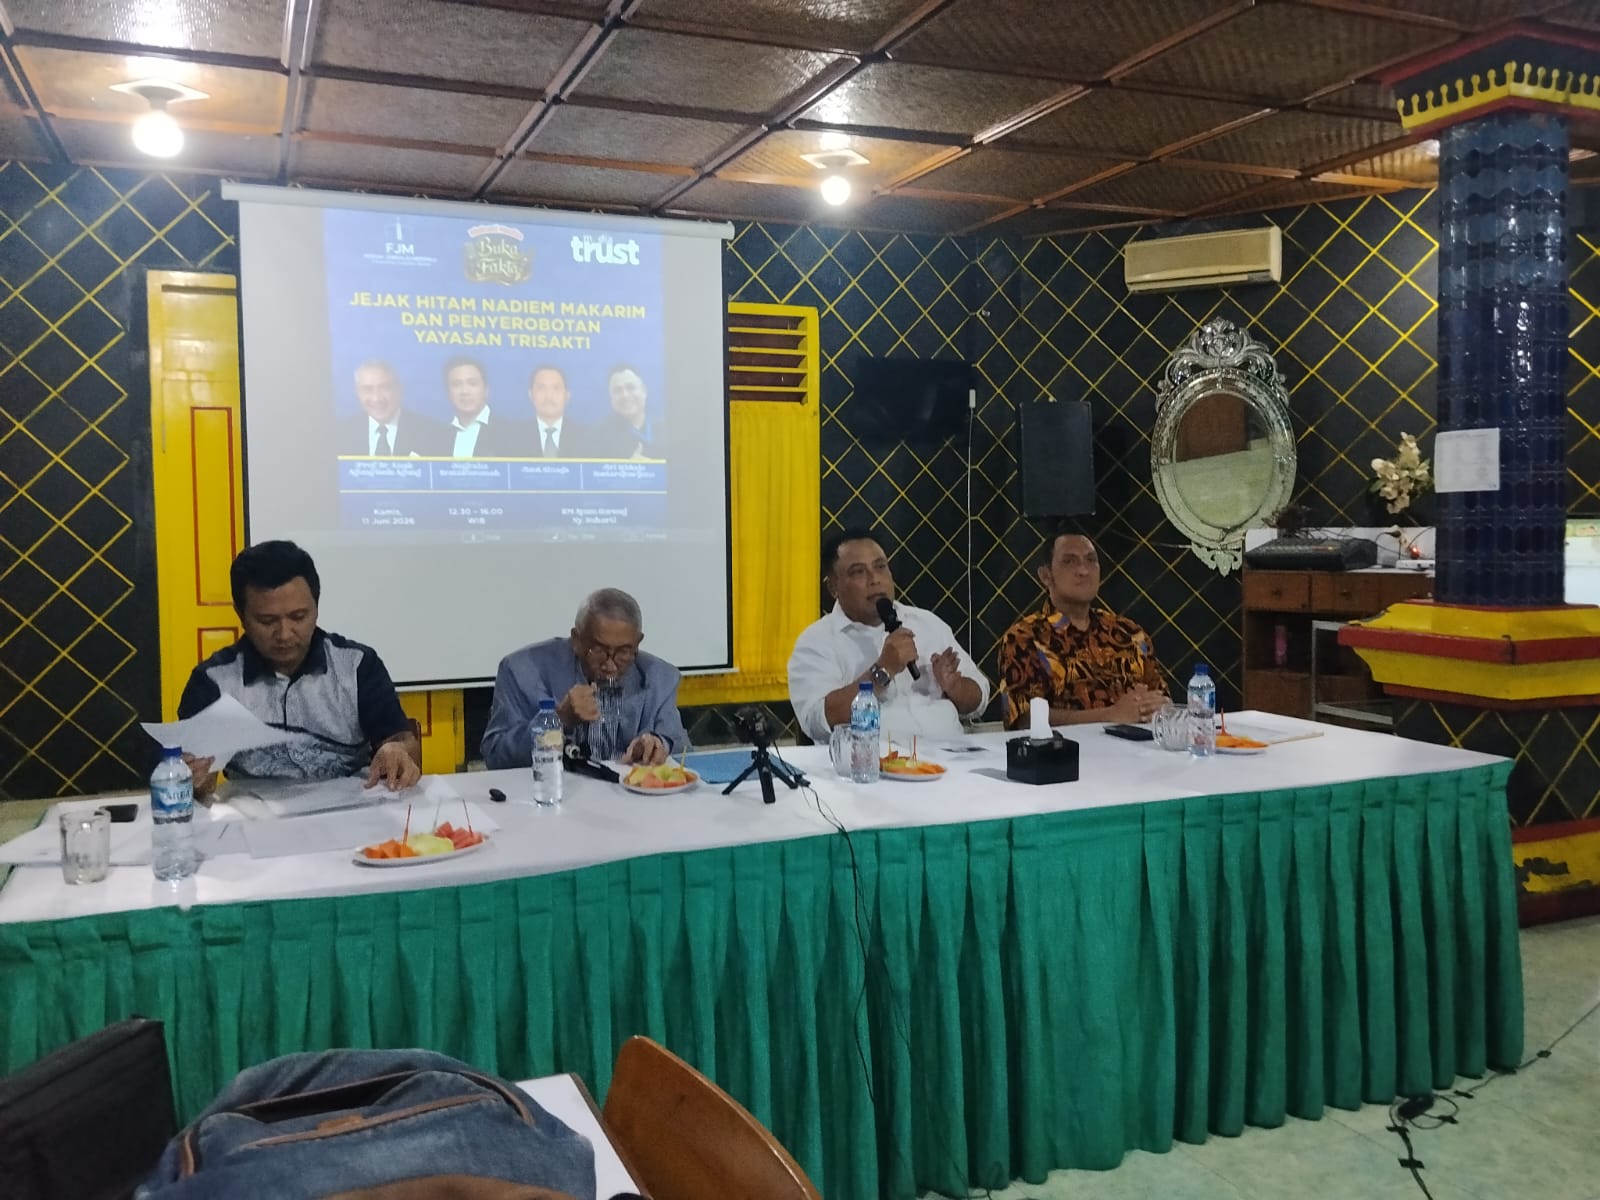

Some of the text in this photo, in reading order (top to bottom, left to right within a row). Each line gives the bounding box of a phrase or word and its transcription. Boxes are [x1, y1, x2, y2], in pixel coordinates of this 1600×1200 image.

[385, 242, 415, 256] FJM
[570, 235, 640, 265] trust
[349, 291, 646, 319] JEJAK HITAM NADIEM MAKARIM
[401, 311, 601, 334] DAN PENYEROBOTAN
[414, 329, 591, 350] YAYASAN TRISAKTI
